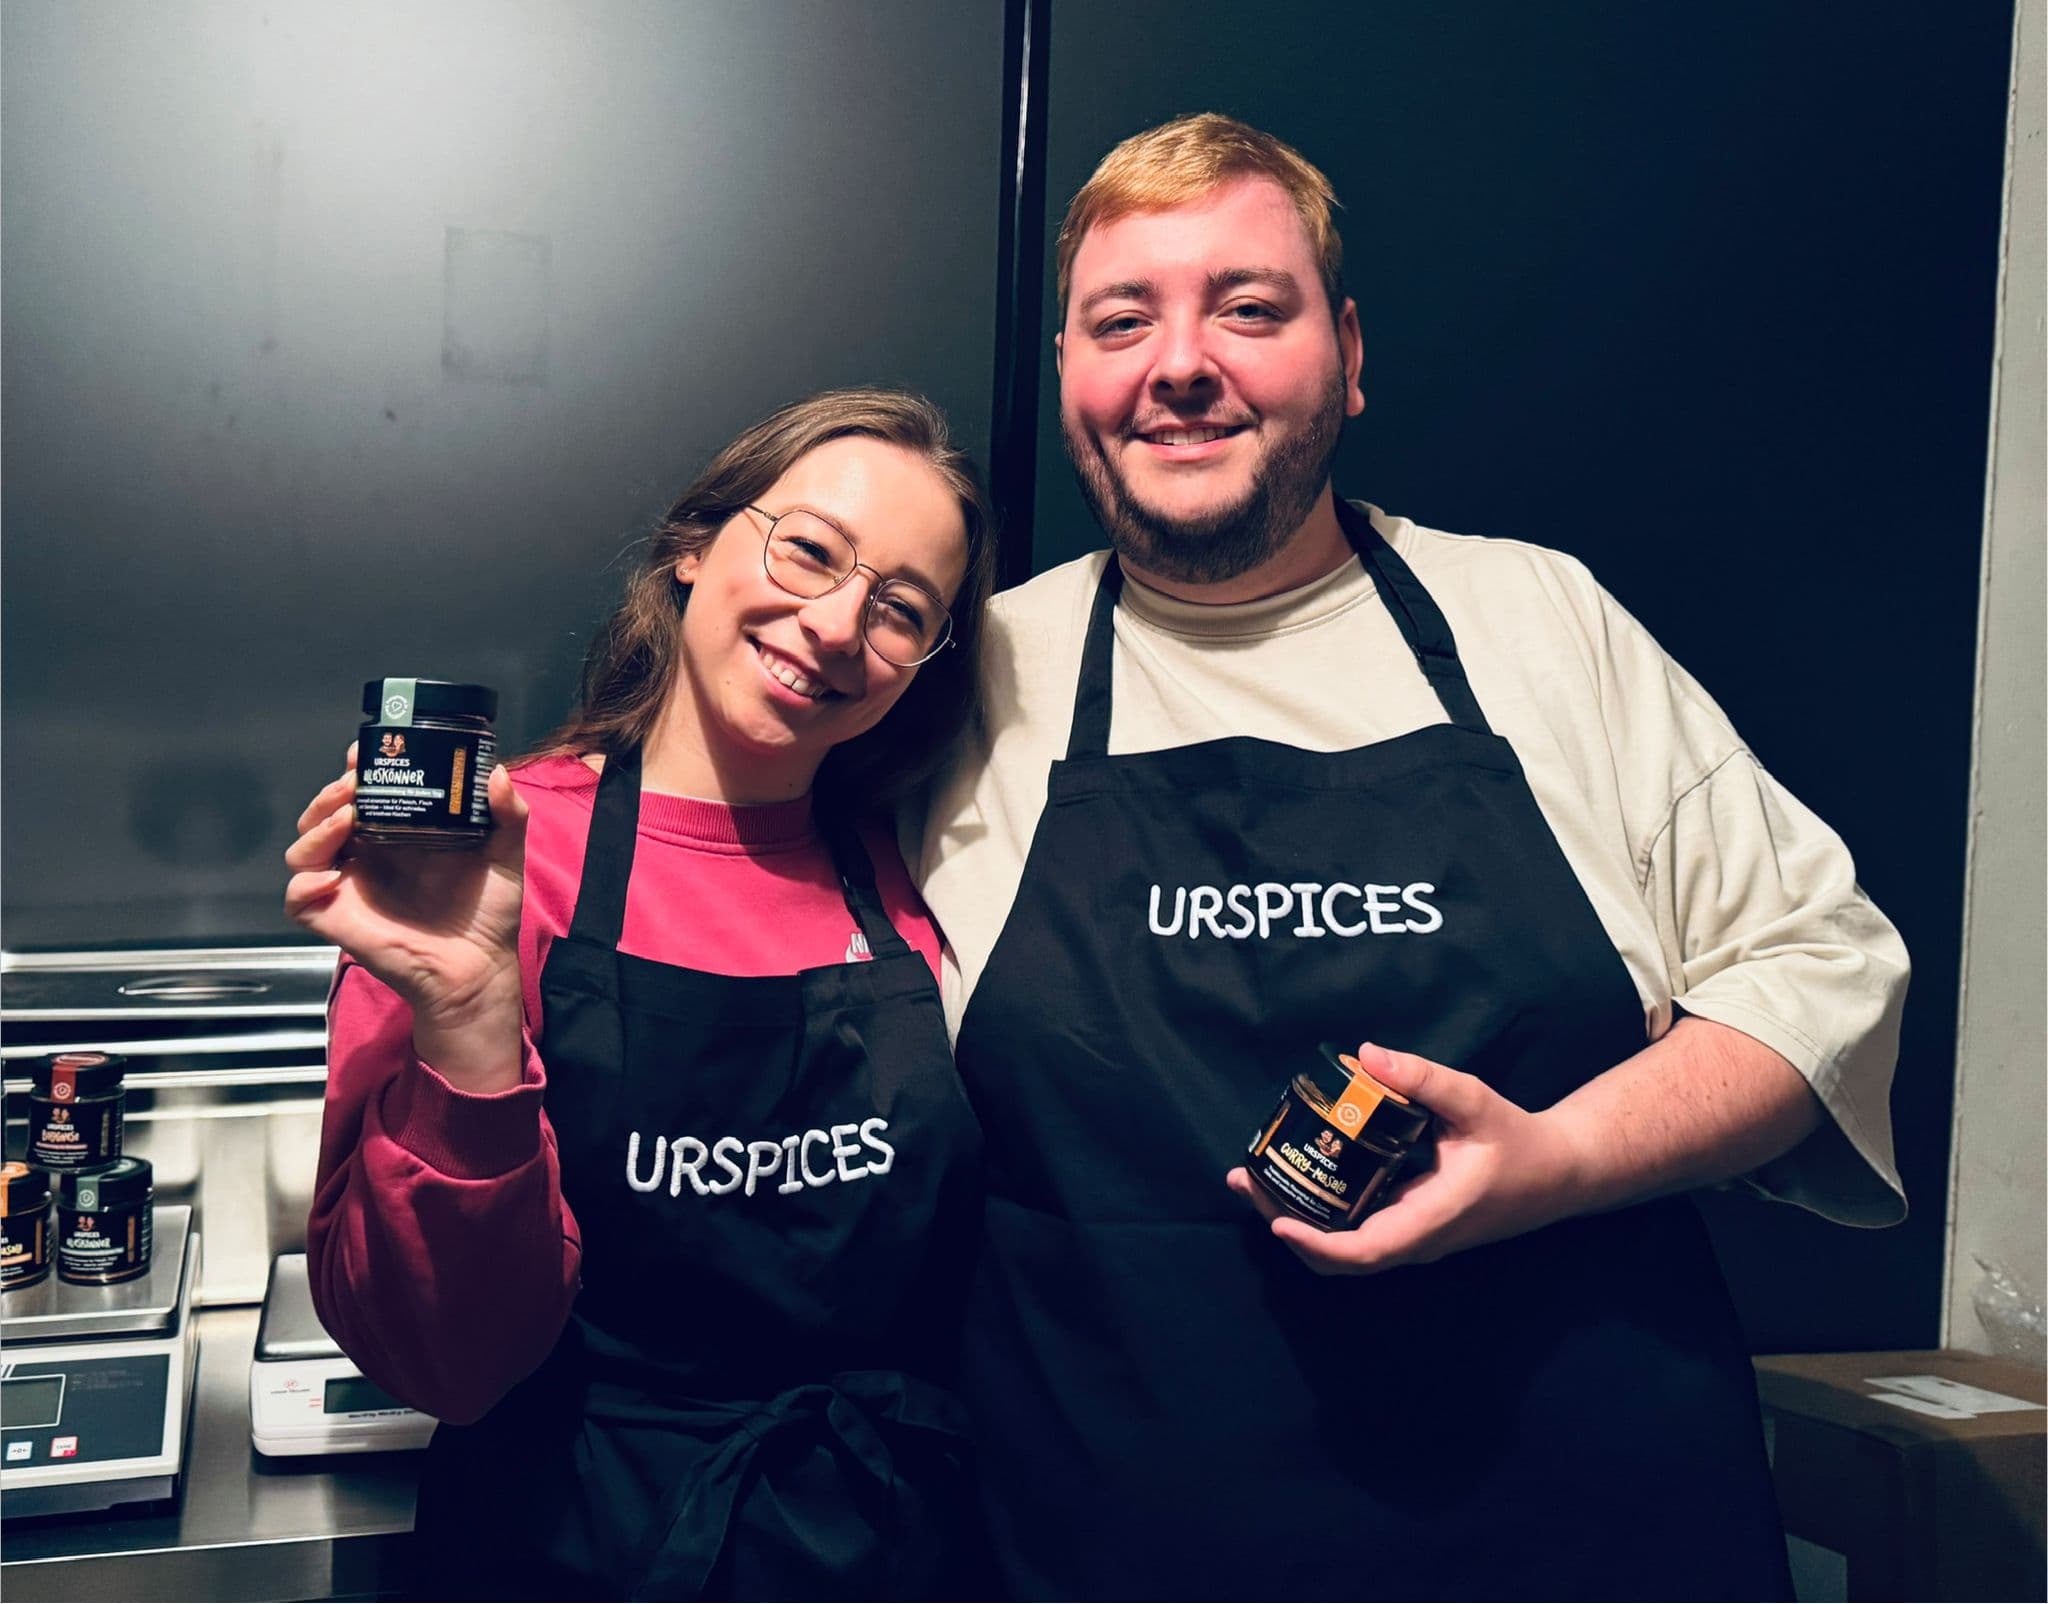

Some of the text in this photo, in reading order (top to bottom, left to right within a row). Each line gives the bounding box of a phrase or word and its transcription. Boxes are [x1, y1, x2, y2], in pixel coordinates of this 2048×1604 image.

[374, 757, 411, 767] URSPICES
[1149, 882, 1444, 940] URSPICES
[626, 1117, 895, 1197] URSPICES
[1303, 1143, 1339, 1171] URSPICES
